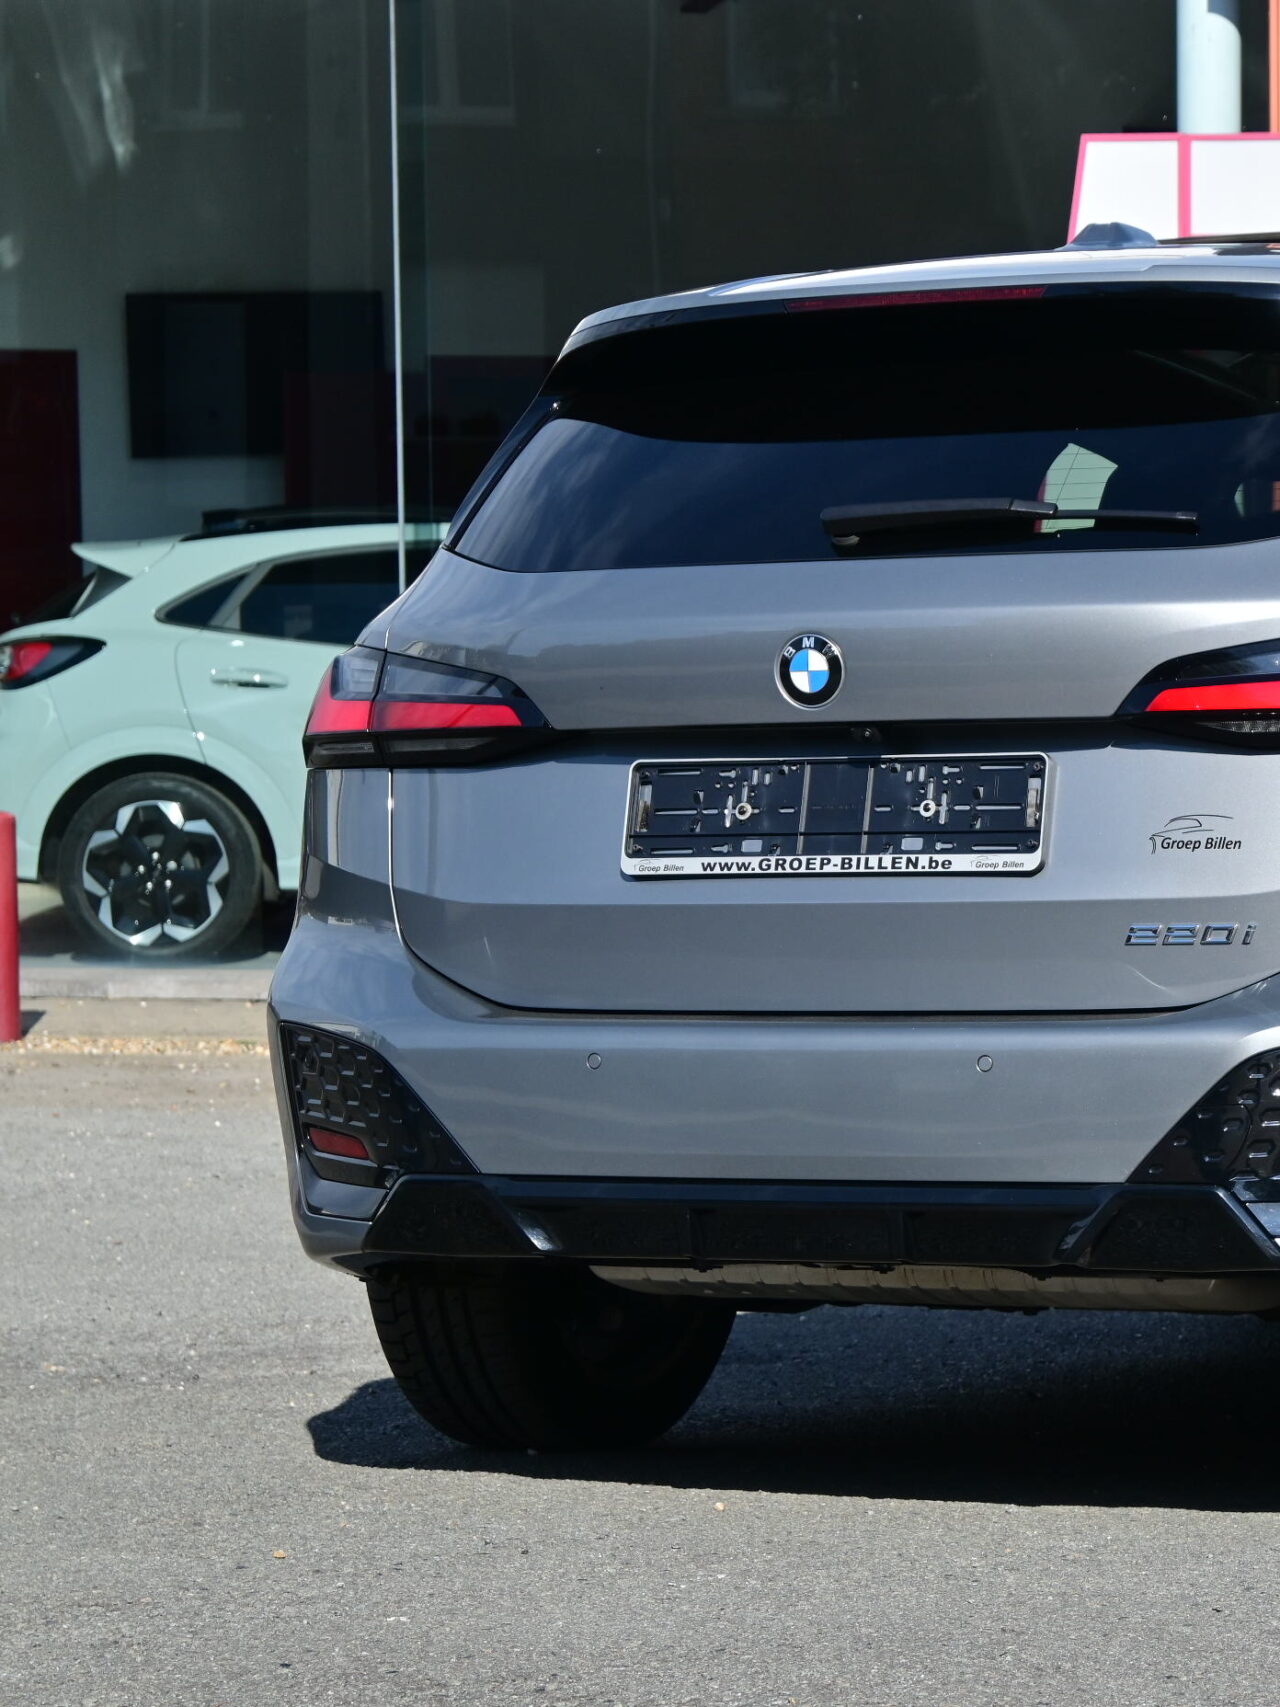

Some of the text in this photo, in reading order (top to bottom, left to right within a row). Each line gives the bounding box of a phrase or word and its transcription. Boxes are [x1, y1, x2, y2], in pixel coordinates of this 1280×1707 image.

[1160, 836, 1242, 853] Groep Billen
[638, 863, 685, 873] Groep Billen
[700, 855, 953, 872] www.GROEP-BILLEN.be
[975, 860, 1025, 870] Groep Billen
[1124, 922, 1257, 946] 220i
